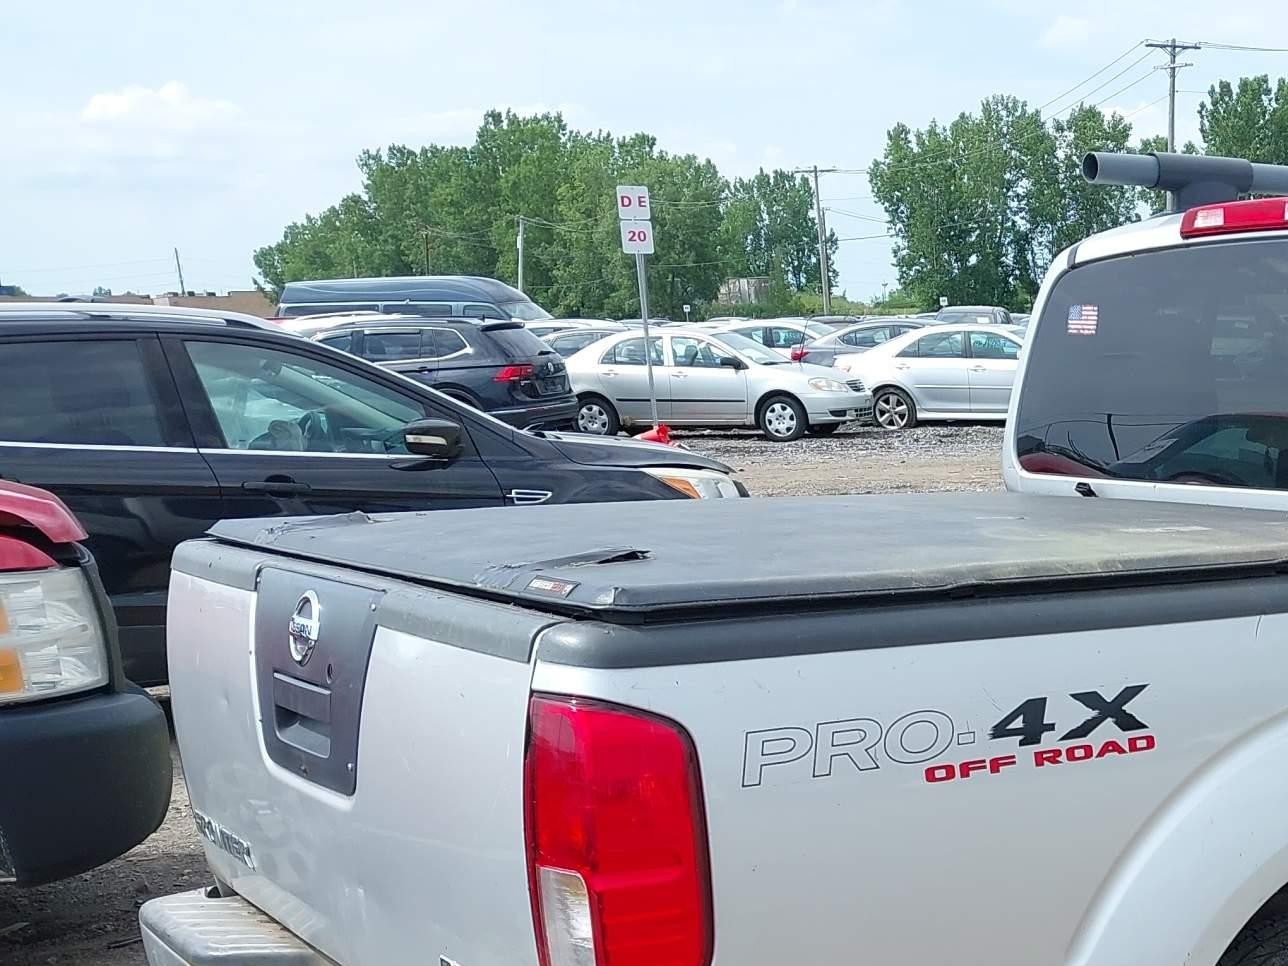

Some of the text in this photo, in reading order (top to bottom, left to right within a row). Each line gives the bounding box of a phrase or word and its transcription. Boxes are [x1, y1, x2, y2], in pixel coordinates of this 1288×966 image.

[620, 195, 647, 208] D E
[627, 230, 647, 242] 20
[740, 683, 1151, 788] PRO-4X
[924, 734, 1156, 784] OFF ROAD
